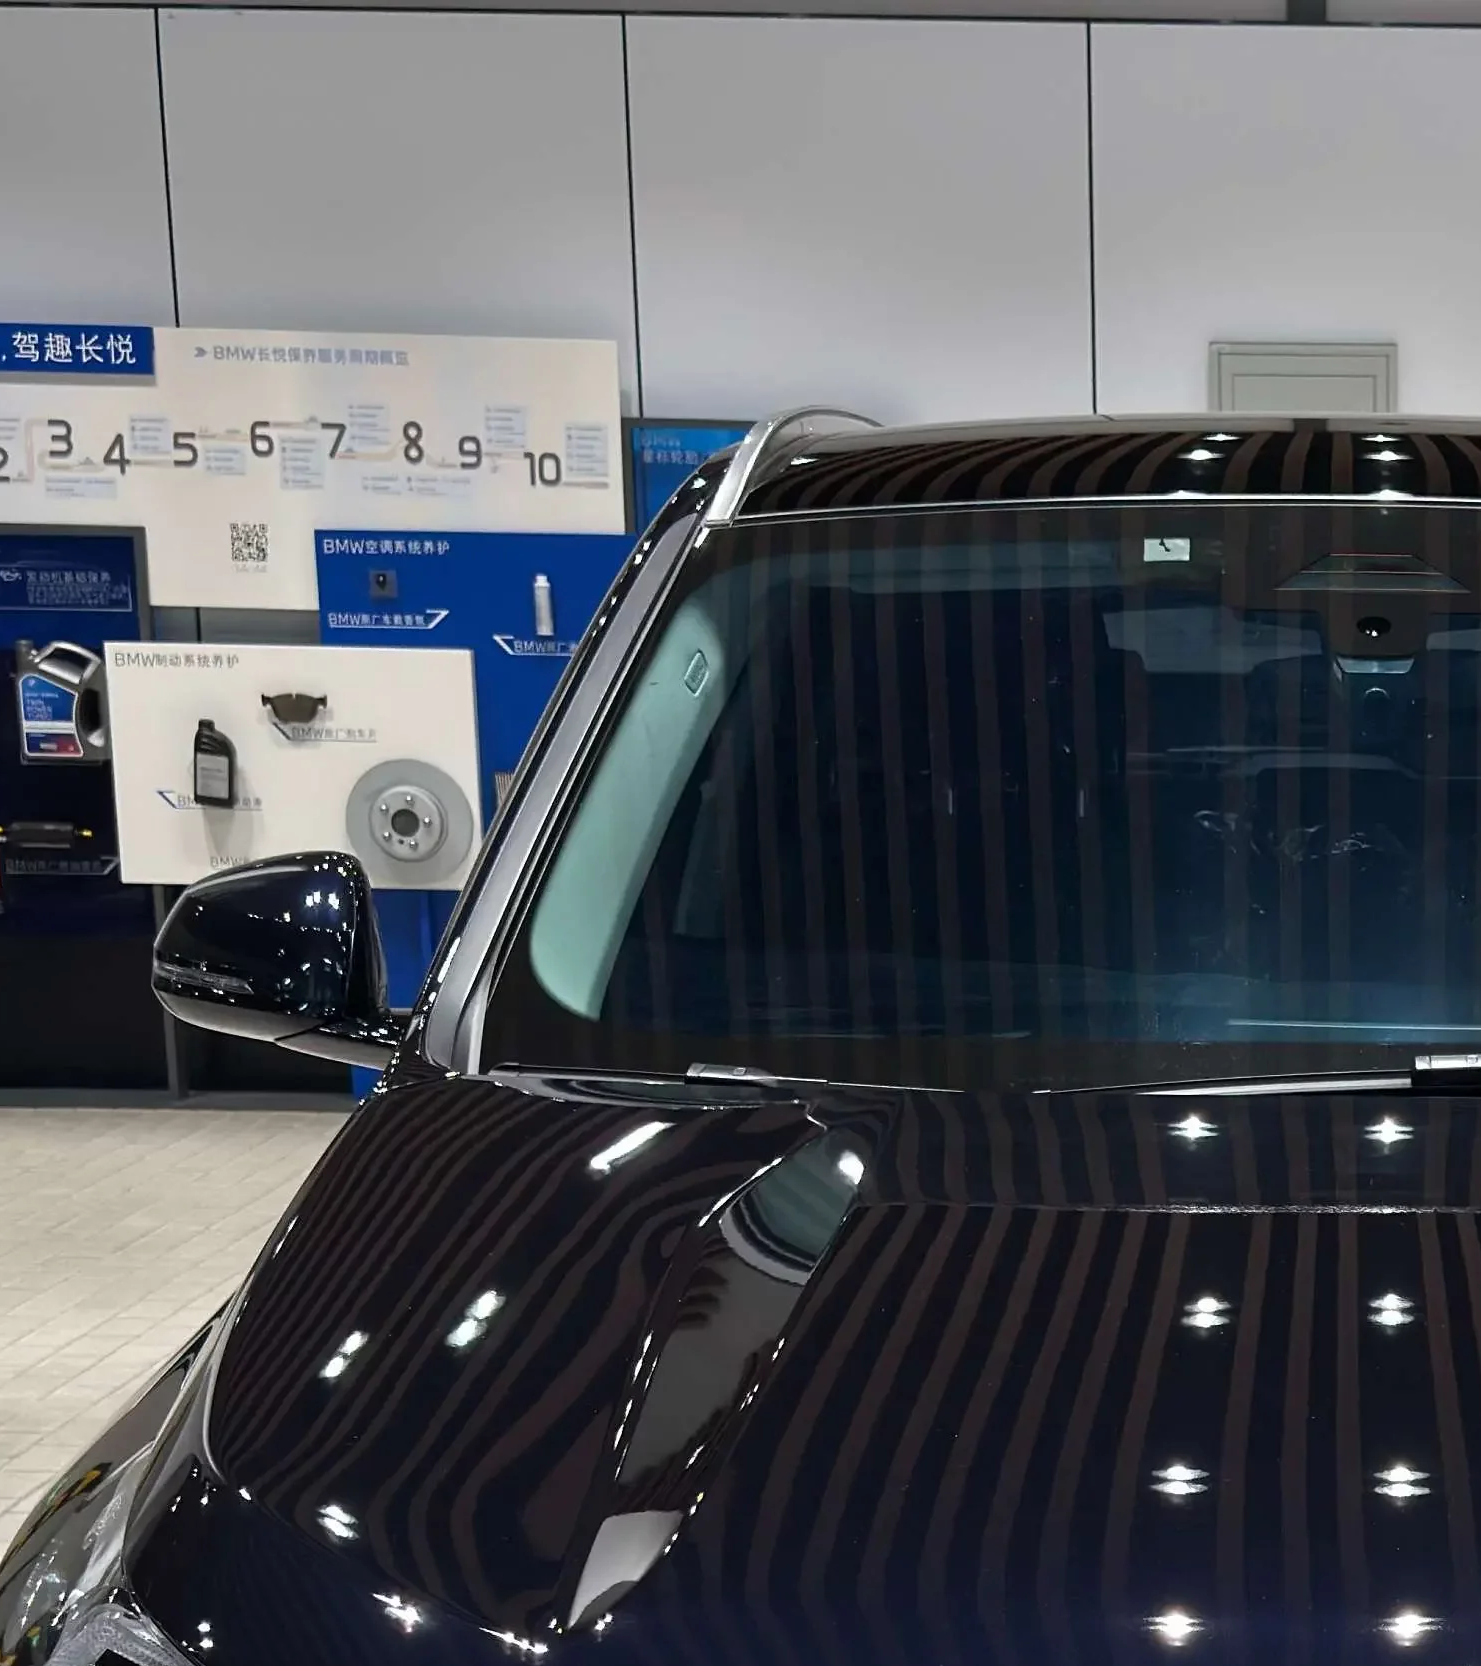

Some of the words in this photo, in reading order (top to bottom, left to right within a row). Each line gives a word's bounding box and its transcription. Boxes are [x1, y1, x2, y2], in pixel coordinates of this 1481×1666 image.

[47, 419, 73, 458] 3
[103, 432, 132, 475] 4
[173, 432, 198, 467] 5
[250, 421, 275, 458] 6
[321, 422, 347, 459] 7
[403, 421, 424, 465] 8
[458, 435, 482, 469] 9
[523, 451, 563, 488] 10
[322, 538, 450, 557] BMW空调系统养护
[114, 652, 240, 669] BMW制动系统养护
